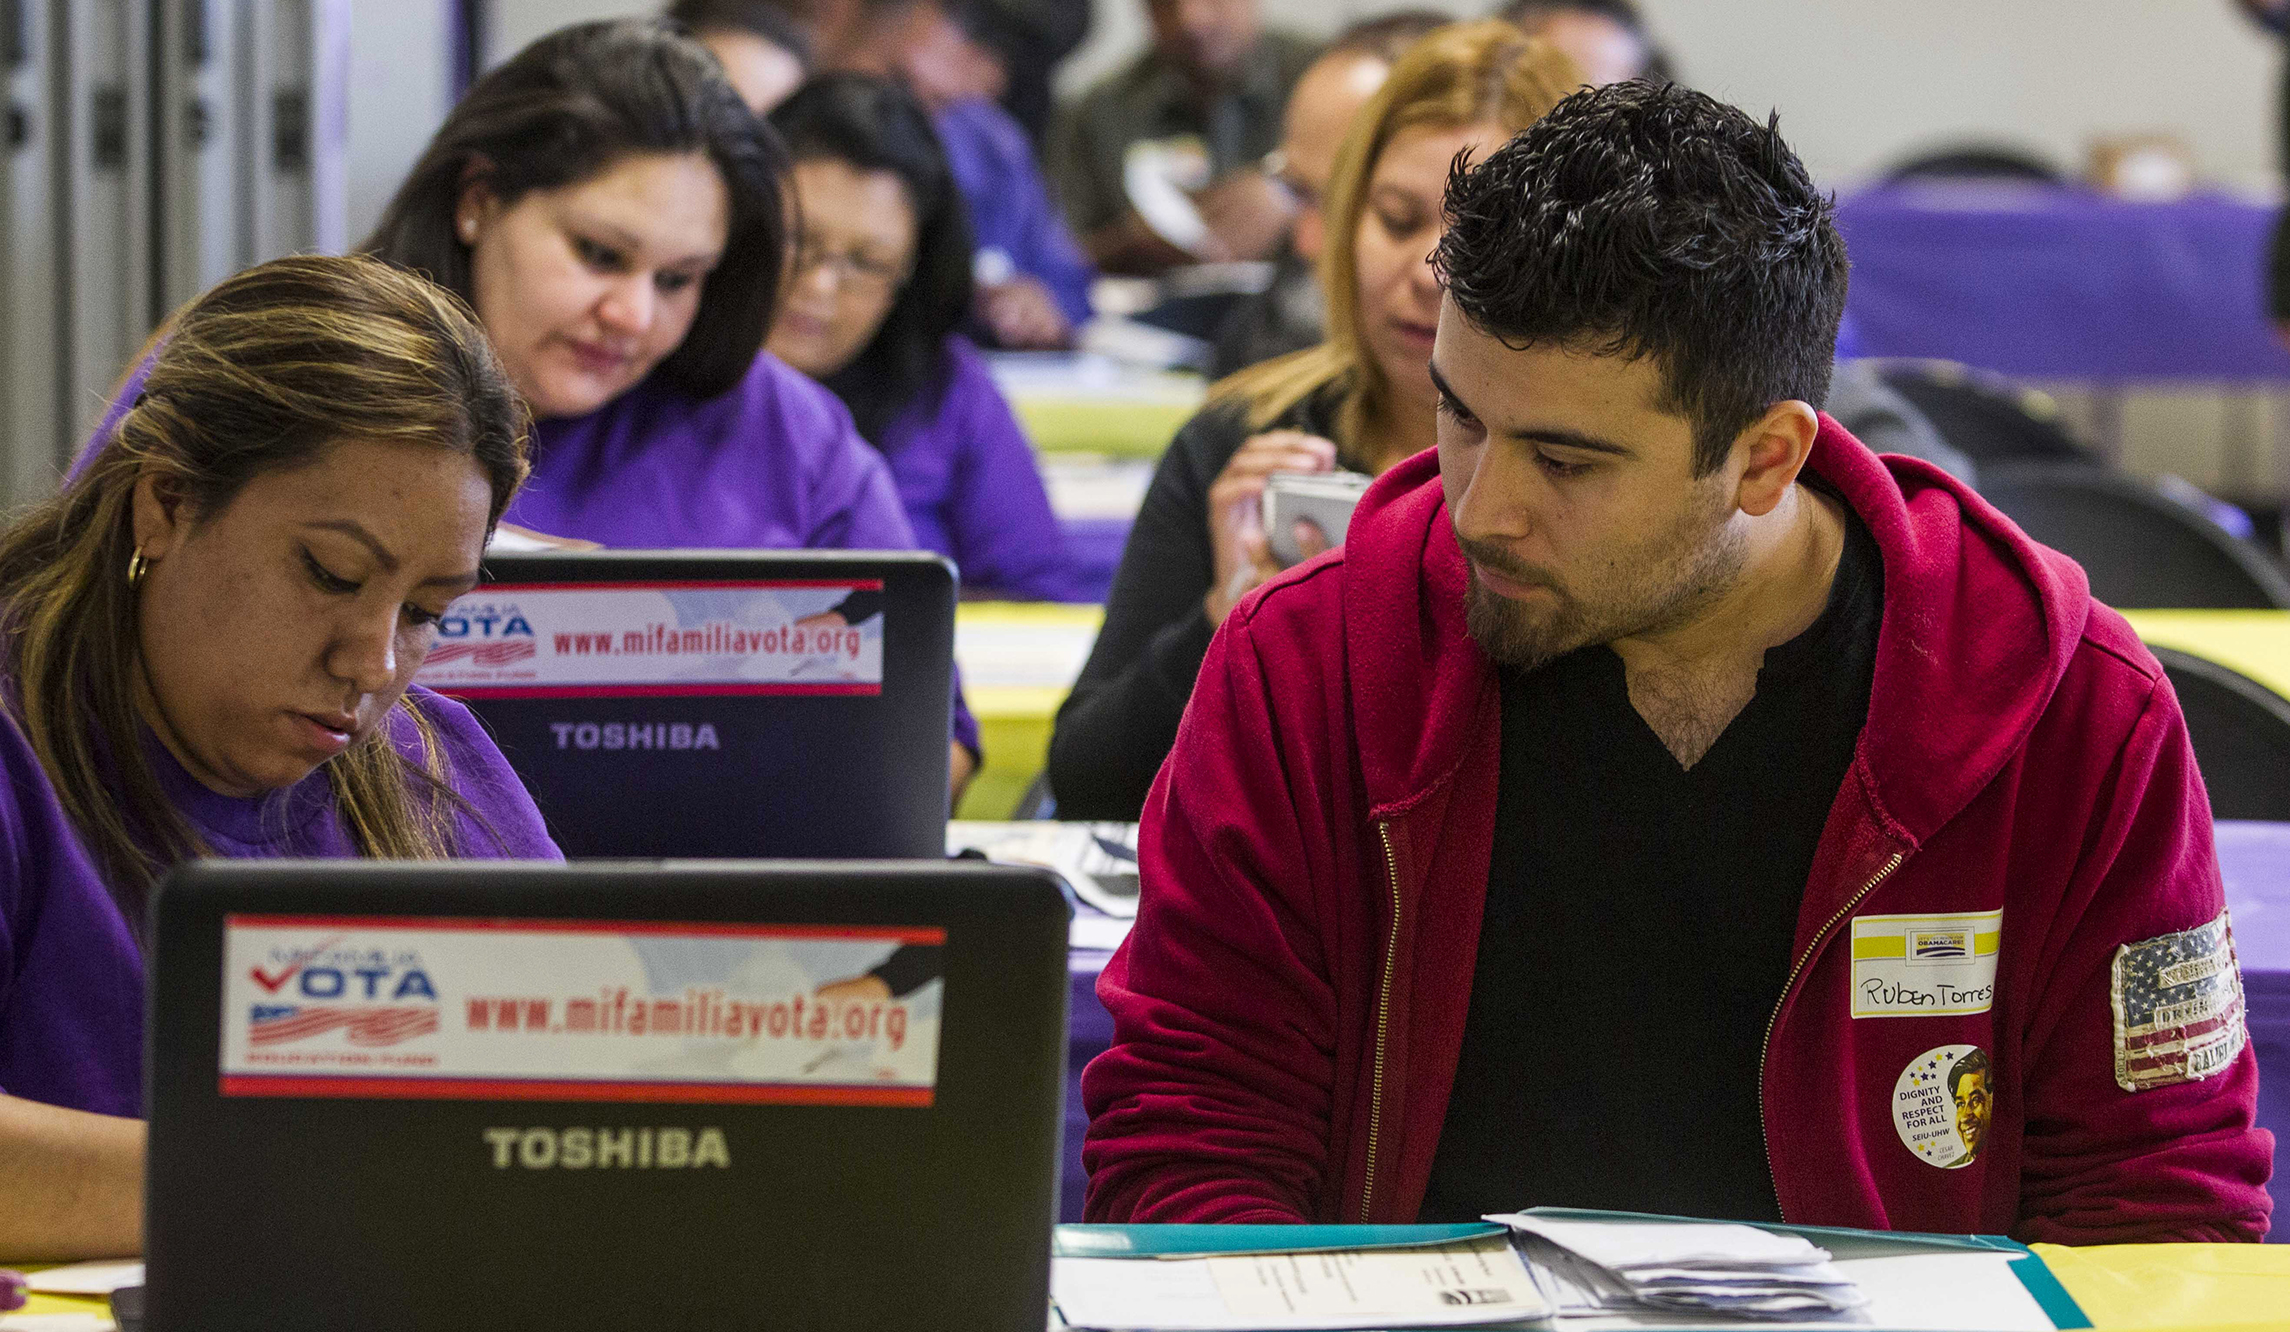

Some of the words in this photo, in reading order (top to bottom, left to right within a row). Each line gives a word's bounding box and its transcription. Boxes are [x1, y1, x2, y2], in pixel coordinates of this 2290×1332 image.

[439, 615, 535, 637] OTA
[553, 620, 861, 660] www.mifamiliavota.org
[550, 722, 719, 750] TOSHIBA
[1860, 977, 1936, 1006] Ruben
[1936, 983, 1992, 1006] Torres
[466, 986, 908, 1050] www.mifamiliavota.org
[1899, 1085, 1941, 1101] DIGNITY
[1921, 1095, 1943, 1107] AND
[1901, 1104, 1945, 1120] RESPECT
[1906, 1118, 1927, 1129] FOR
[1929, 1114, 1948, 1126] ALL
[1912, 1127, 1951, 1142] SEIU-UHW
[483, 1125, 731, 1169] TOSHIBA
